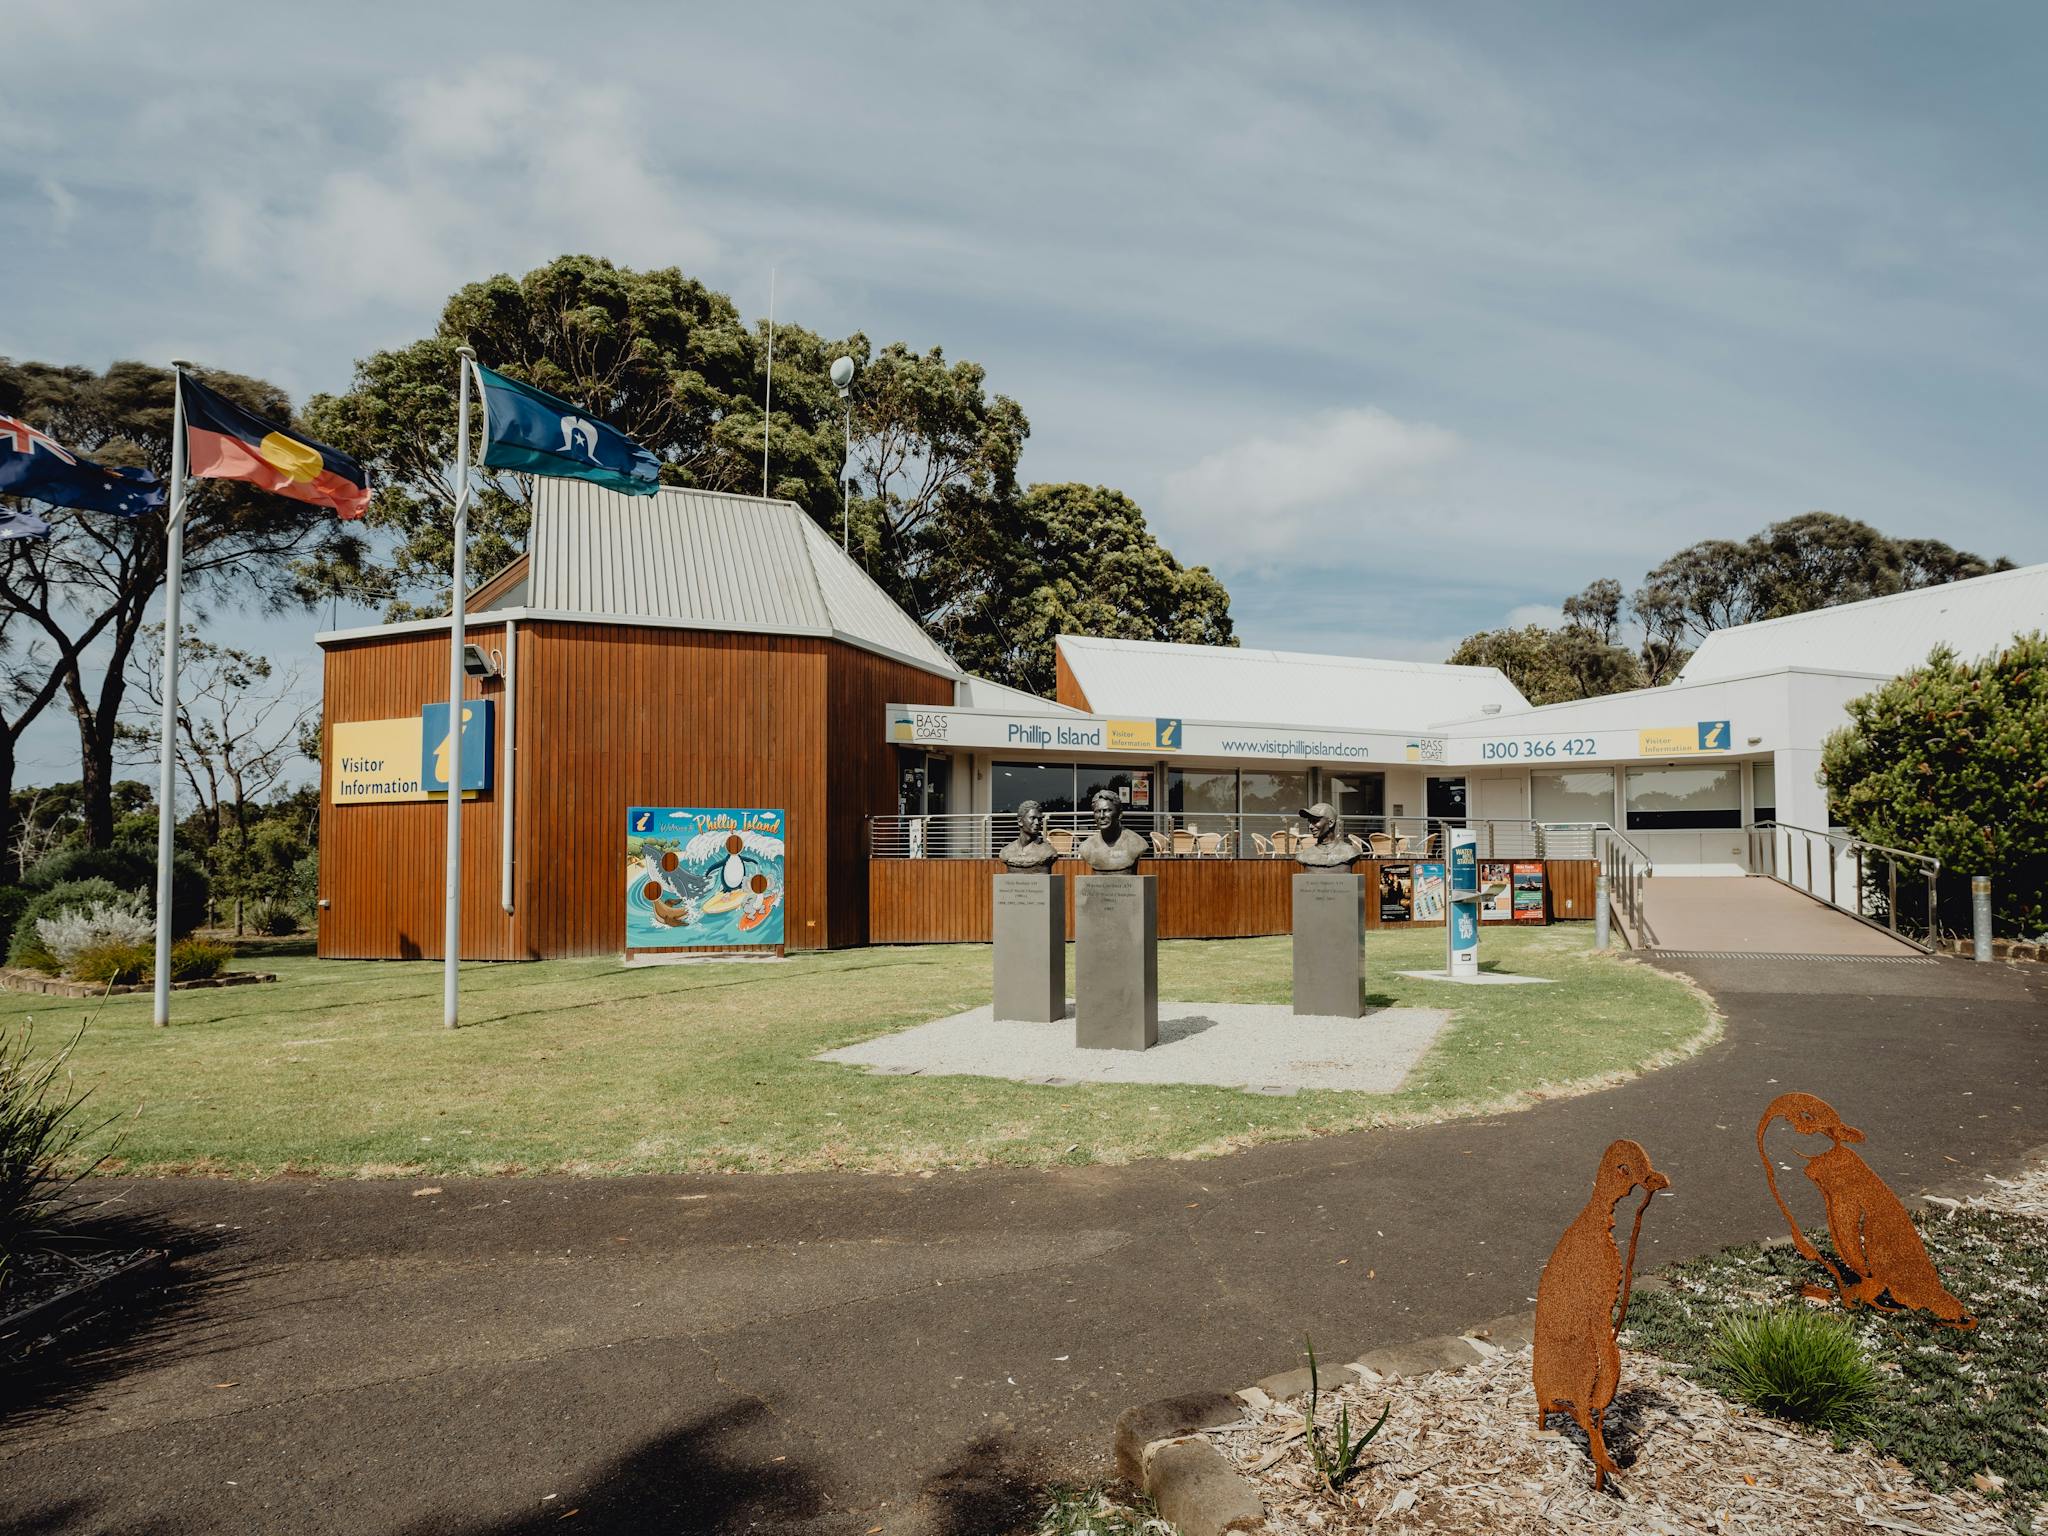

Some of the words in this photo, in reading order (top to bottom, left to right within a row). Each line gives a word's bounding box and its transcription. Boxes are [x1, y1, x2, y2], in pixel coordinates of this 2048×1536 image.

[916, 714, 948, 728] BASS
[916, 728, 948, 738] COAST
[1008, 723, 1051, 749] Phillip
[1057, 726, 1100, 746] Island
[1111, 730, 1135, 738] Visitor
[1111, 738, 1151, 747] Information
[1420, 739, 1443, 751] BASS
[1644, 736, 1672, 744] Visitor
[1221, 740, 1369, 758] www.visitphillipisland.com
[1420, 750, 1443, 760] COAST
[1482, 742, 1518, 759] 1300
[1523, 740, 1556, 758] 366
[1562, 738, 1597, 756] 422
[1644, 745, 1693, 753] Information
[341, 757, 385, 773] Visitor
[340, 777, 418, 796] Information
[693, 813, 738, 835] Phillip
[741, 811, 781, 834] Island
